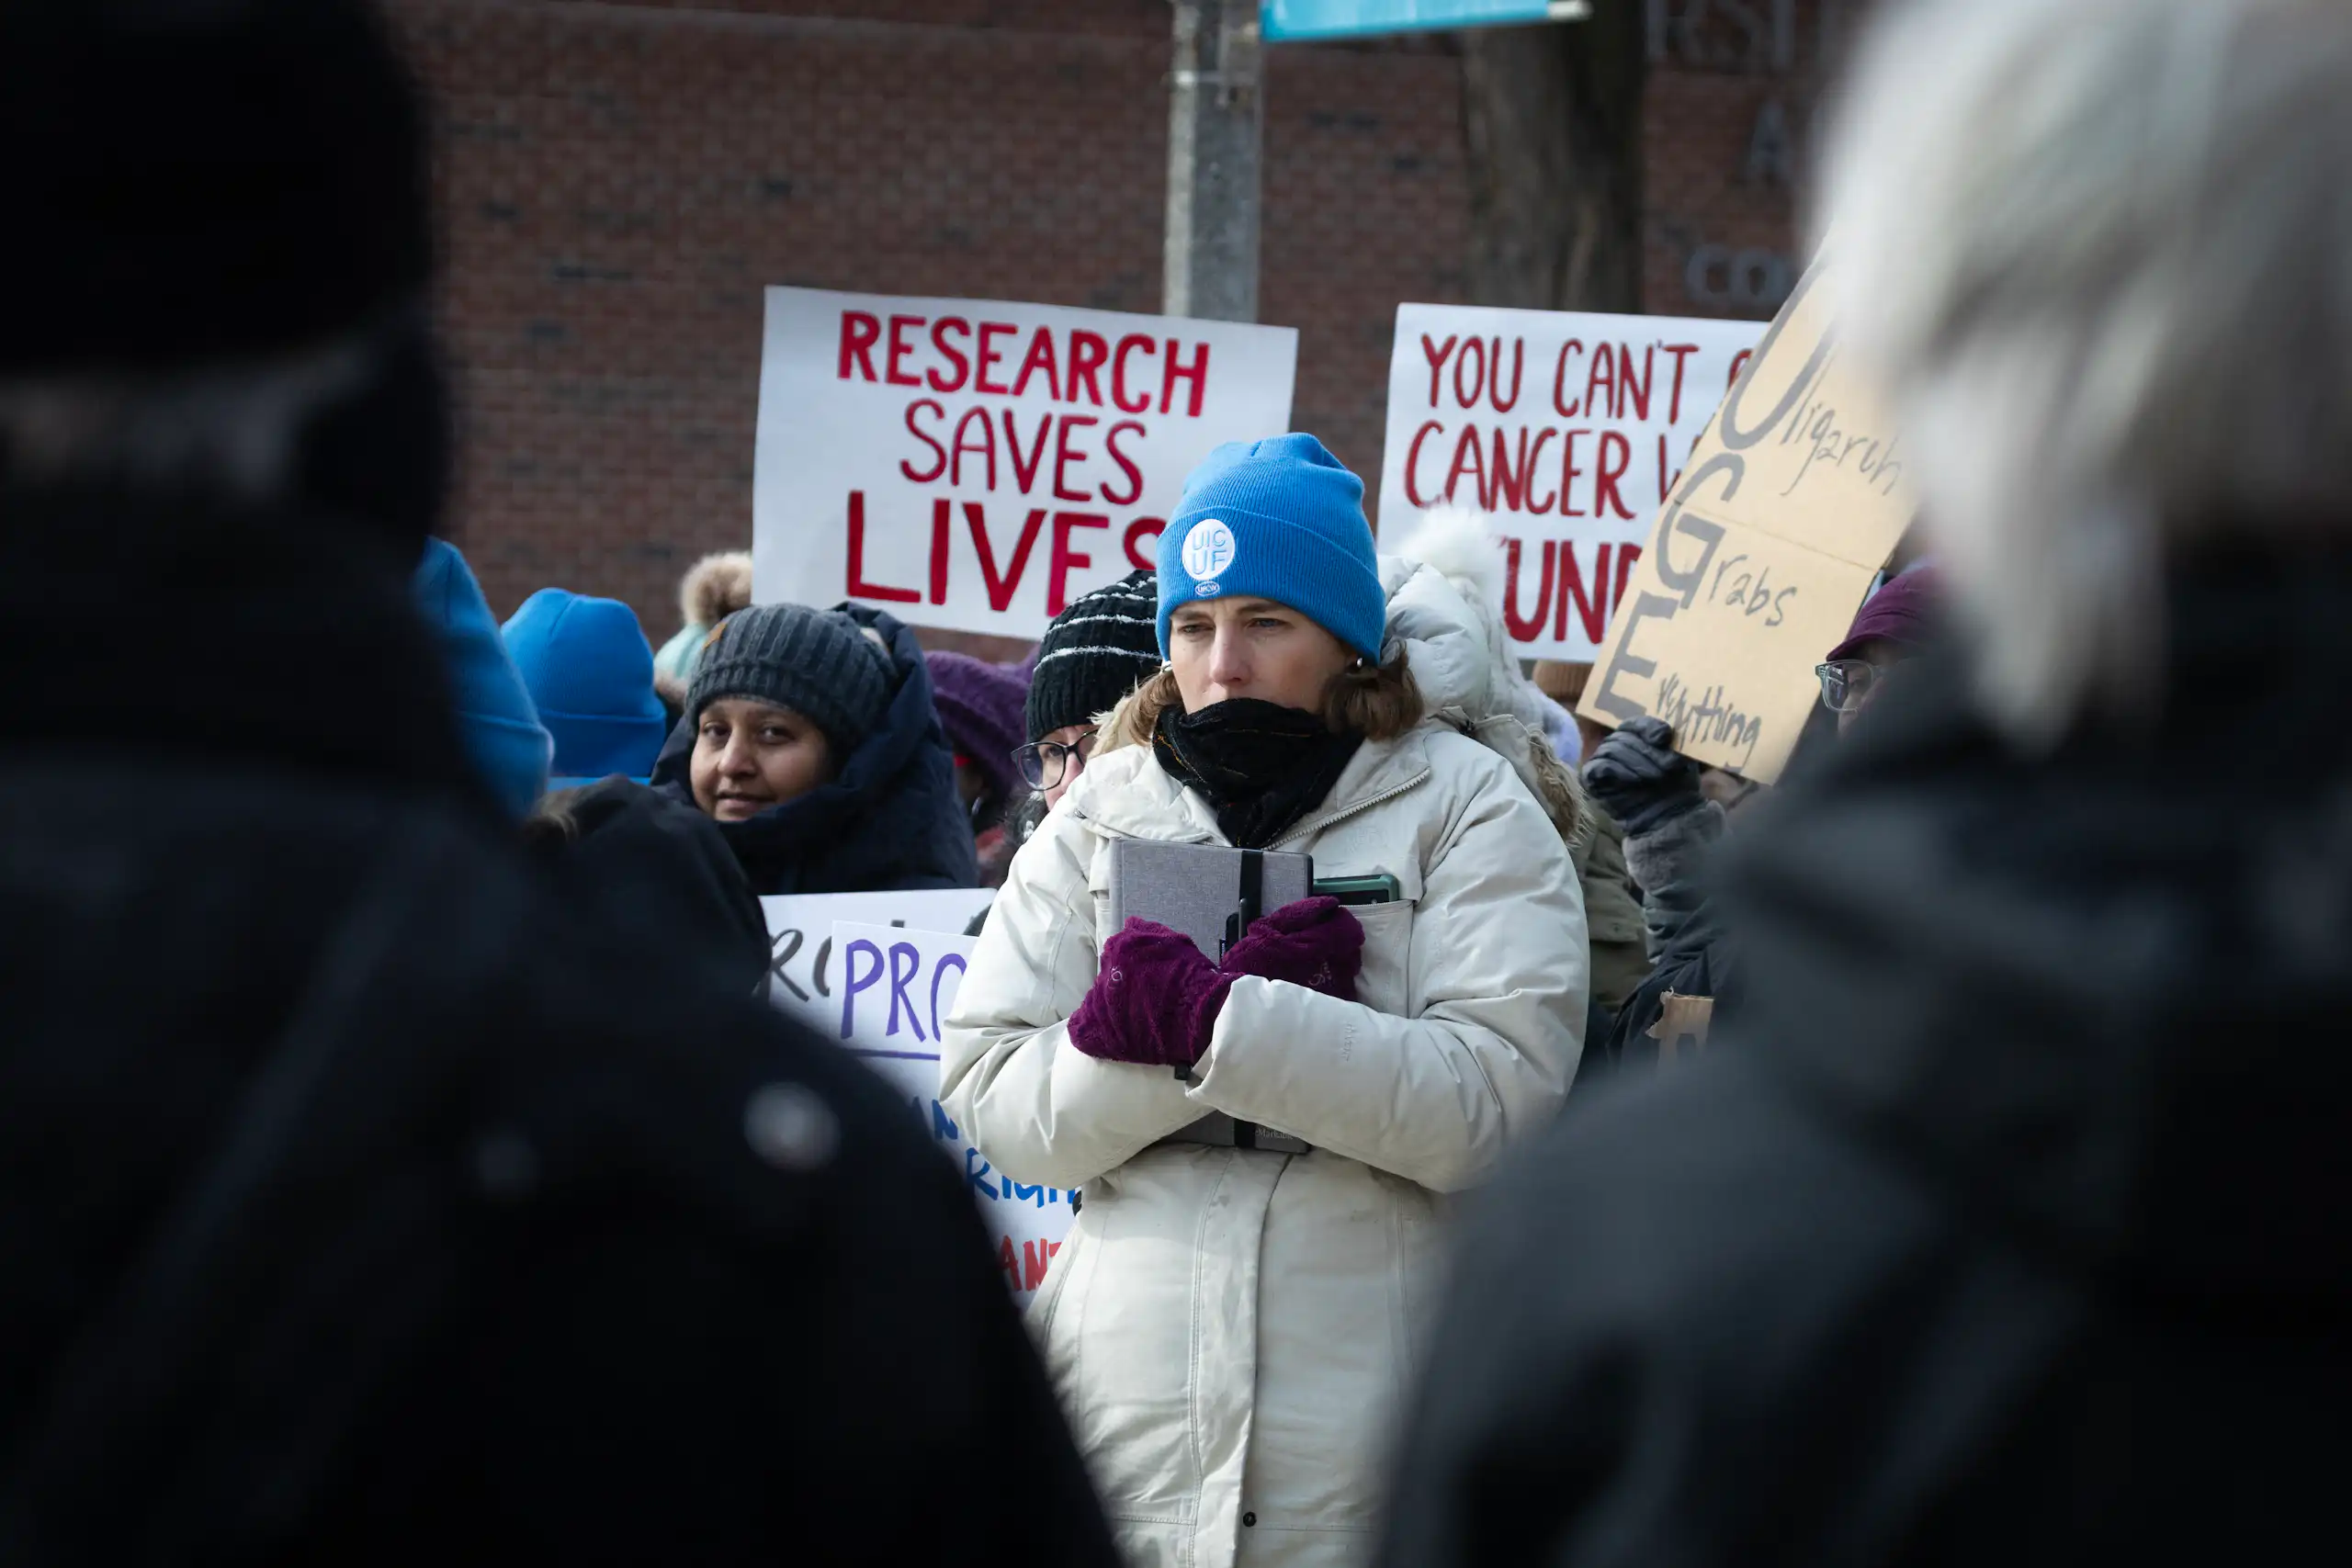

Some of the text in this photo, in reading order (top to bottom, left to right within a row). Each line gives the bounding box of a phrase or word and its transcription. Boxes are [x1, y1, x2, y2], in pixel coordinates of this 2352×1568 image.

[837, 310, 1210, 417] RESEARCH
[1420, 333, 1524, 413] YOU
[1554, 338, 1701, 425] CAN'T
[900, 399, 1147, 506] SAVES
[1404, 419, 1637, 521] CANCER
[1193, 529, 1227, 550] UIC
[1193, 549, 1227, 575] UF
[1498, 536, 1643, 645] UN
[1657, 453, 1798, 628] Grabs
